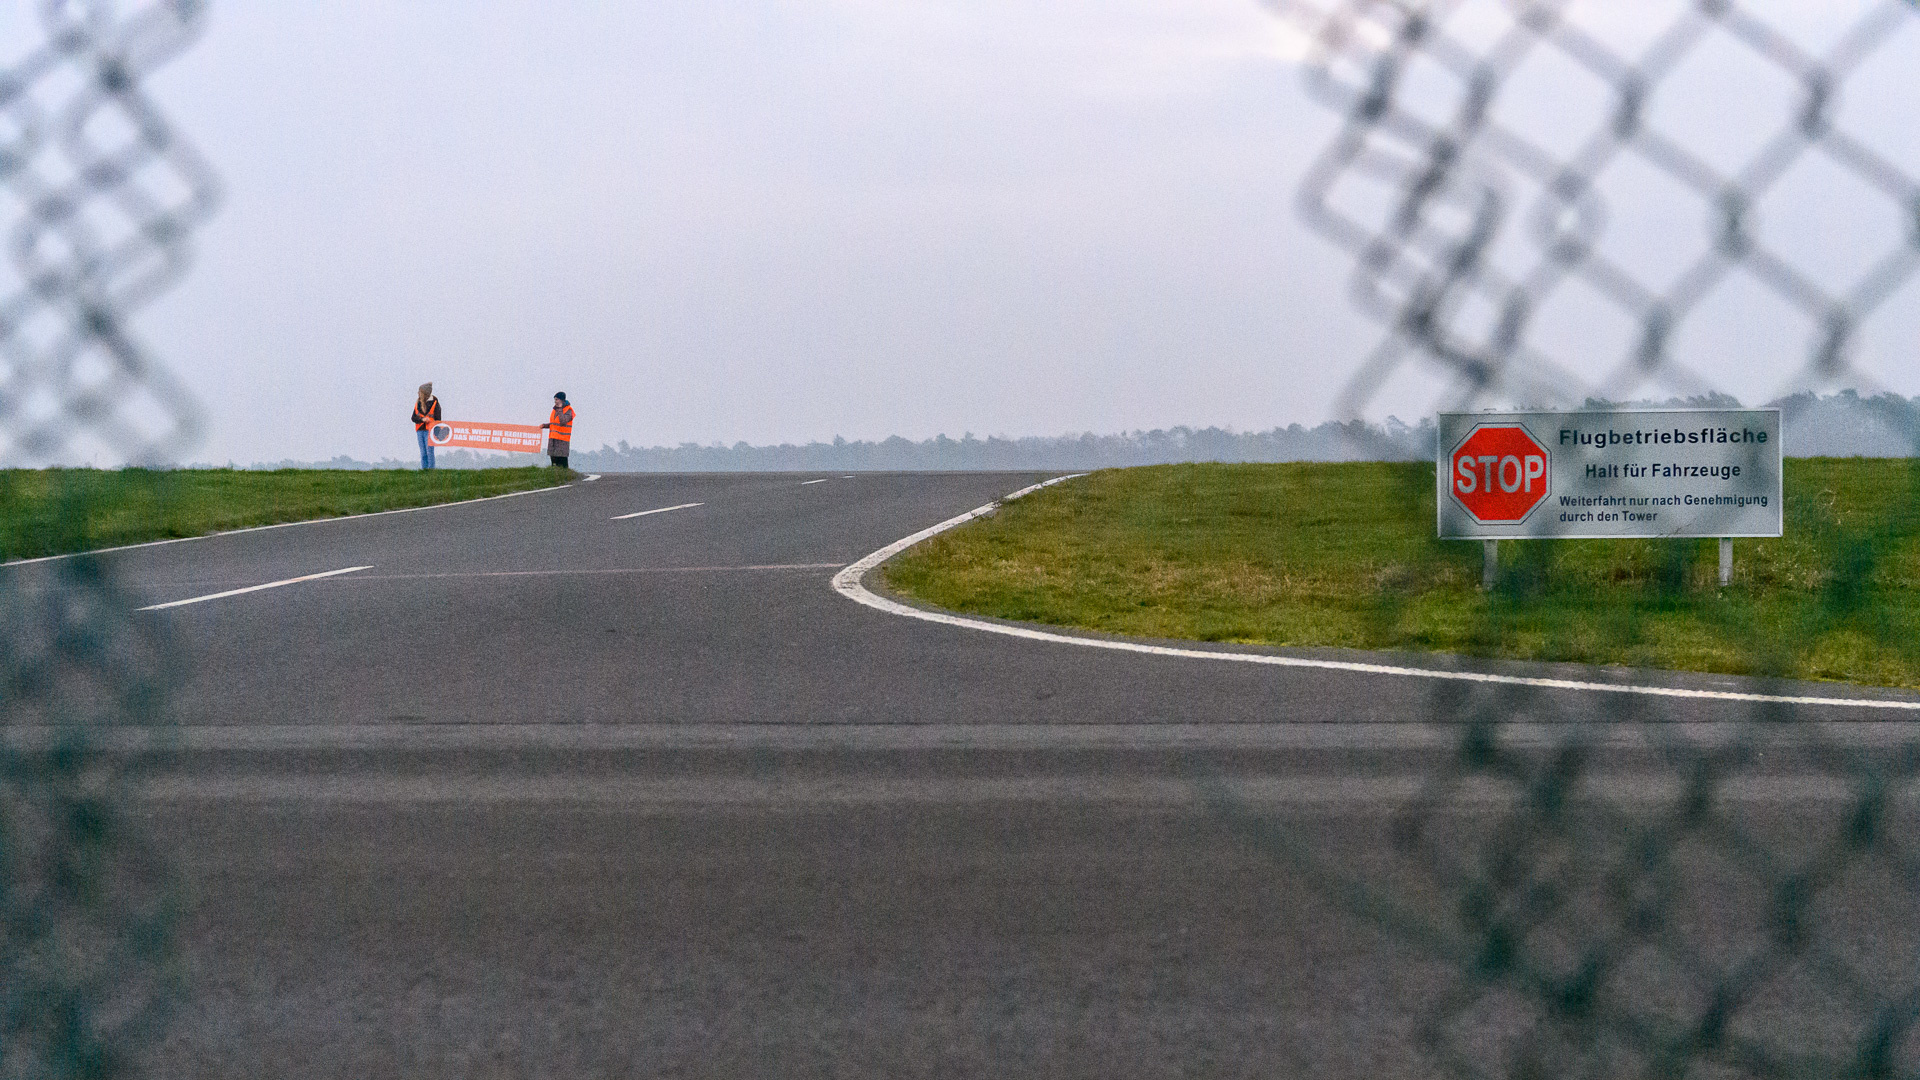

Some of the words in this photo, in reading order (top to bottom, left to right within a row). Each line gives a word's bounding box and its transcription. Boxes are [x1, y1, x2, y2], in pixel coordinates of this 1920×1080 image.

[502, 437, 521, 445] GRIFF
[504, 430, 541, 439] REGIERUNG
[1559, 428, 1768, 448] Flugbetriebsfläche
[1457, 455, 1544, 493] STOP
[1586, 464, 1618, 479] Halt
[1623, 463, 1647, 478] für
[1652, 463, 1741, 479] Fahrzeuge
[1559, 495, 1626, 507] Weiterfahrt
[1629, 497, 1650, 506] nur
[1652, 494, 1681, 506] nach
[1684, 494, 1768, 507] Genehmigung
[1559, 510, 1594, 522] durch
[1597, 510, 1619, 522] den
[1622, 510, 1658, 521] Tower
